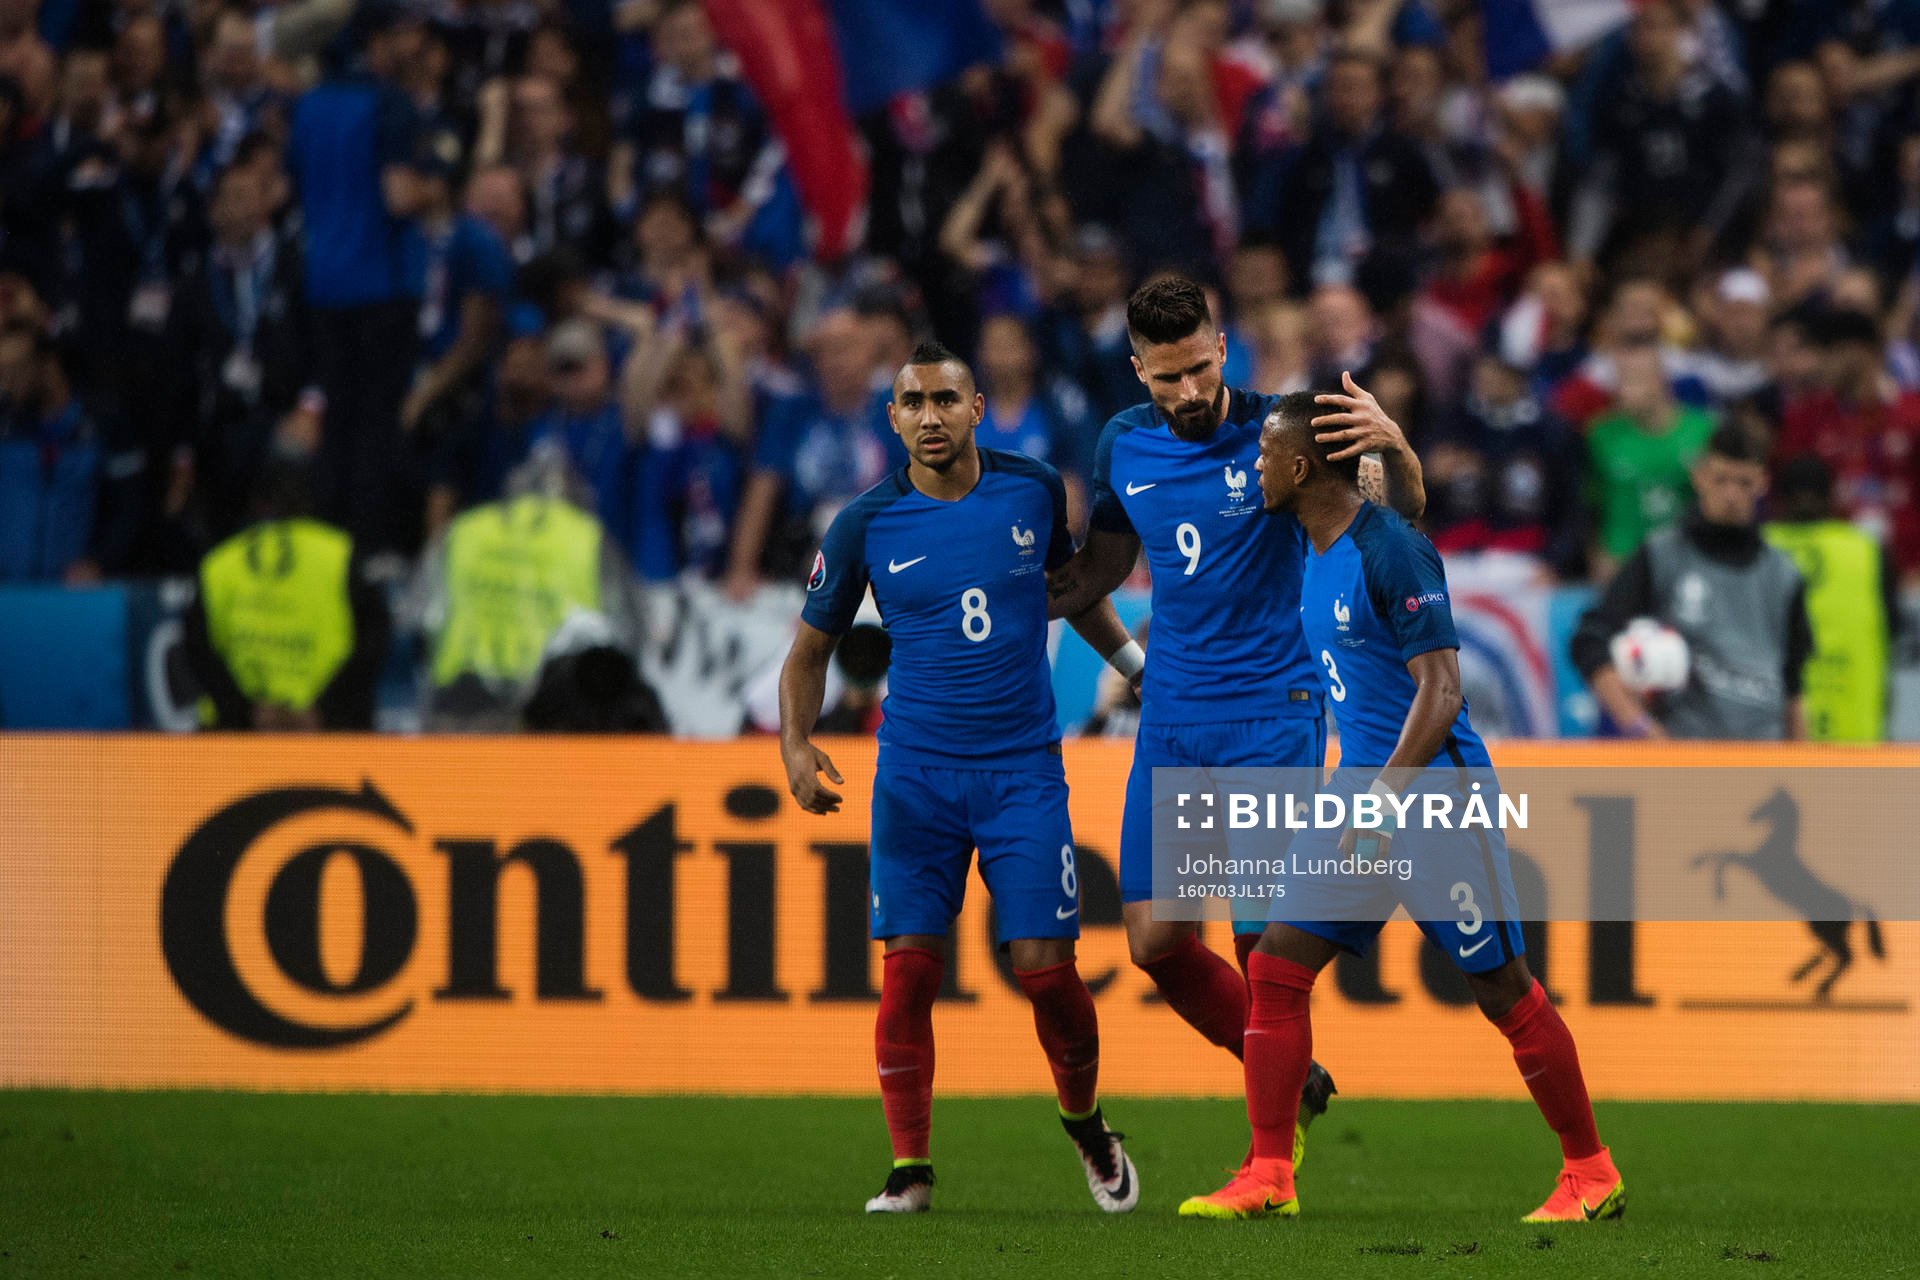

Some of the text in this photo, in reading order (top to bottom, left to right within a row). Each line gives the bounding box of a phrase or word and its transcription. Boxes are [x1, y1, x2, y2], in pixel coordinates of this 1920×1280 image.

[1176, 523, 1202, 575] 9
[961, 587, 992, 642] 8
[1321, 649, 1346, 702] 3
[1061, 844, 1077, 898] 8
[158, 776, 1658, 1052] Continl
[1450, 881, 1483, 936] 3
